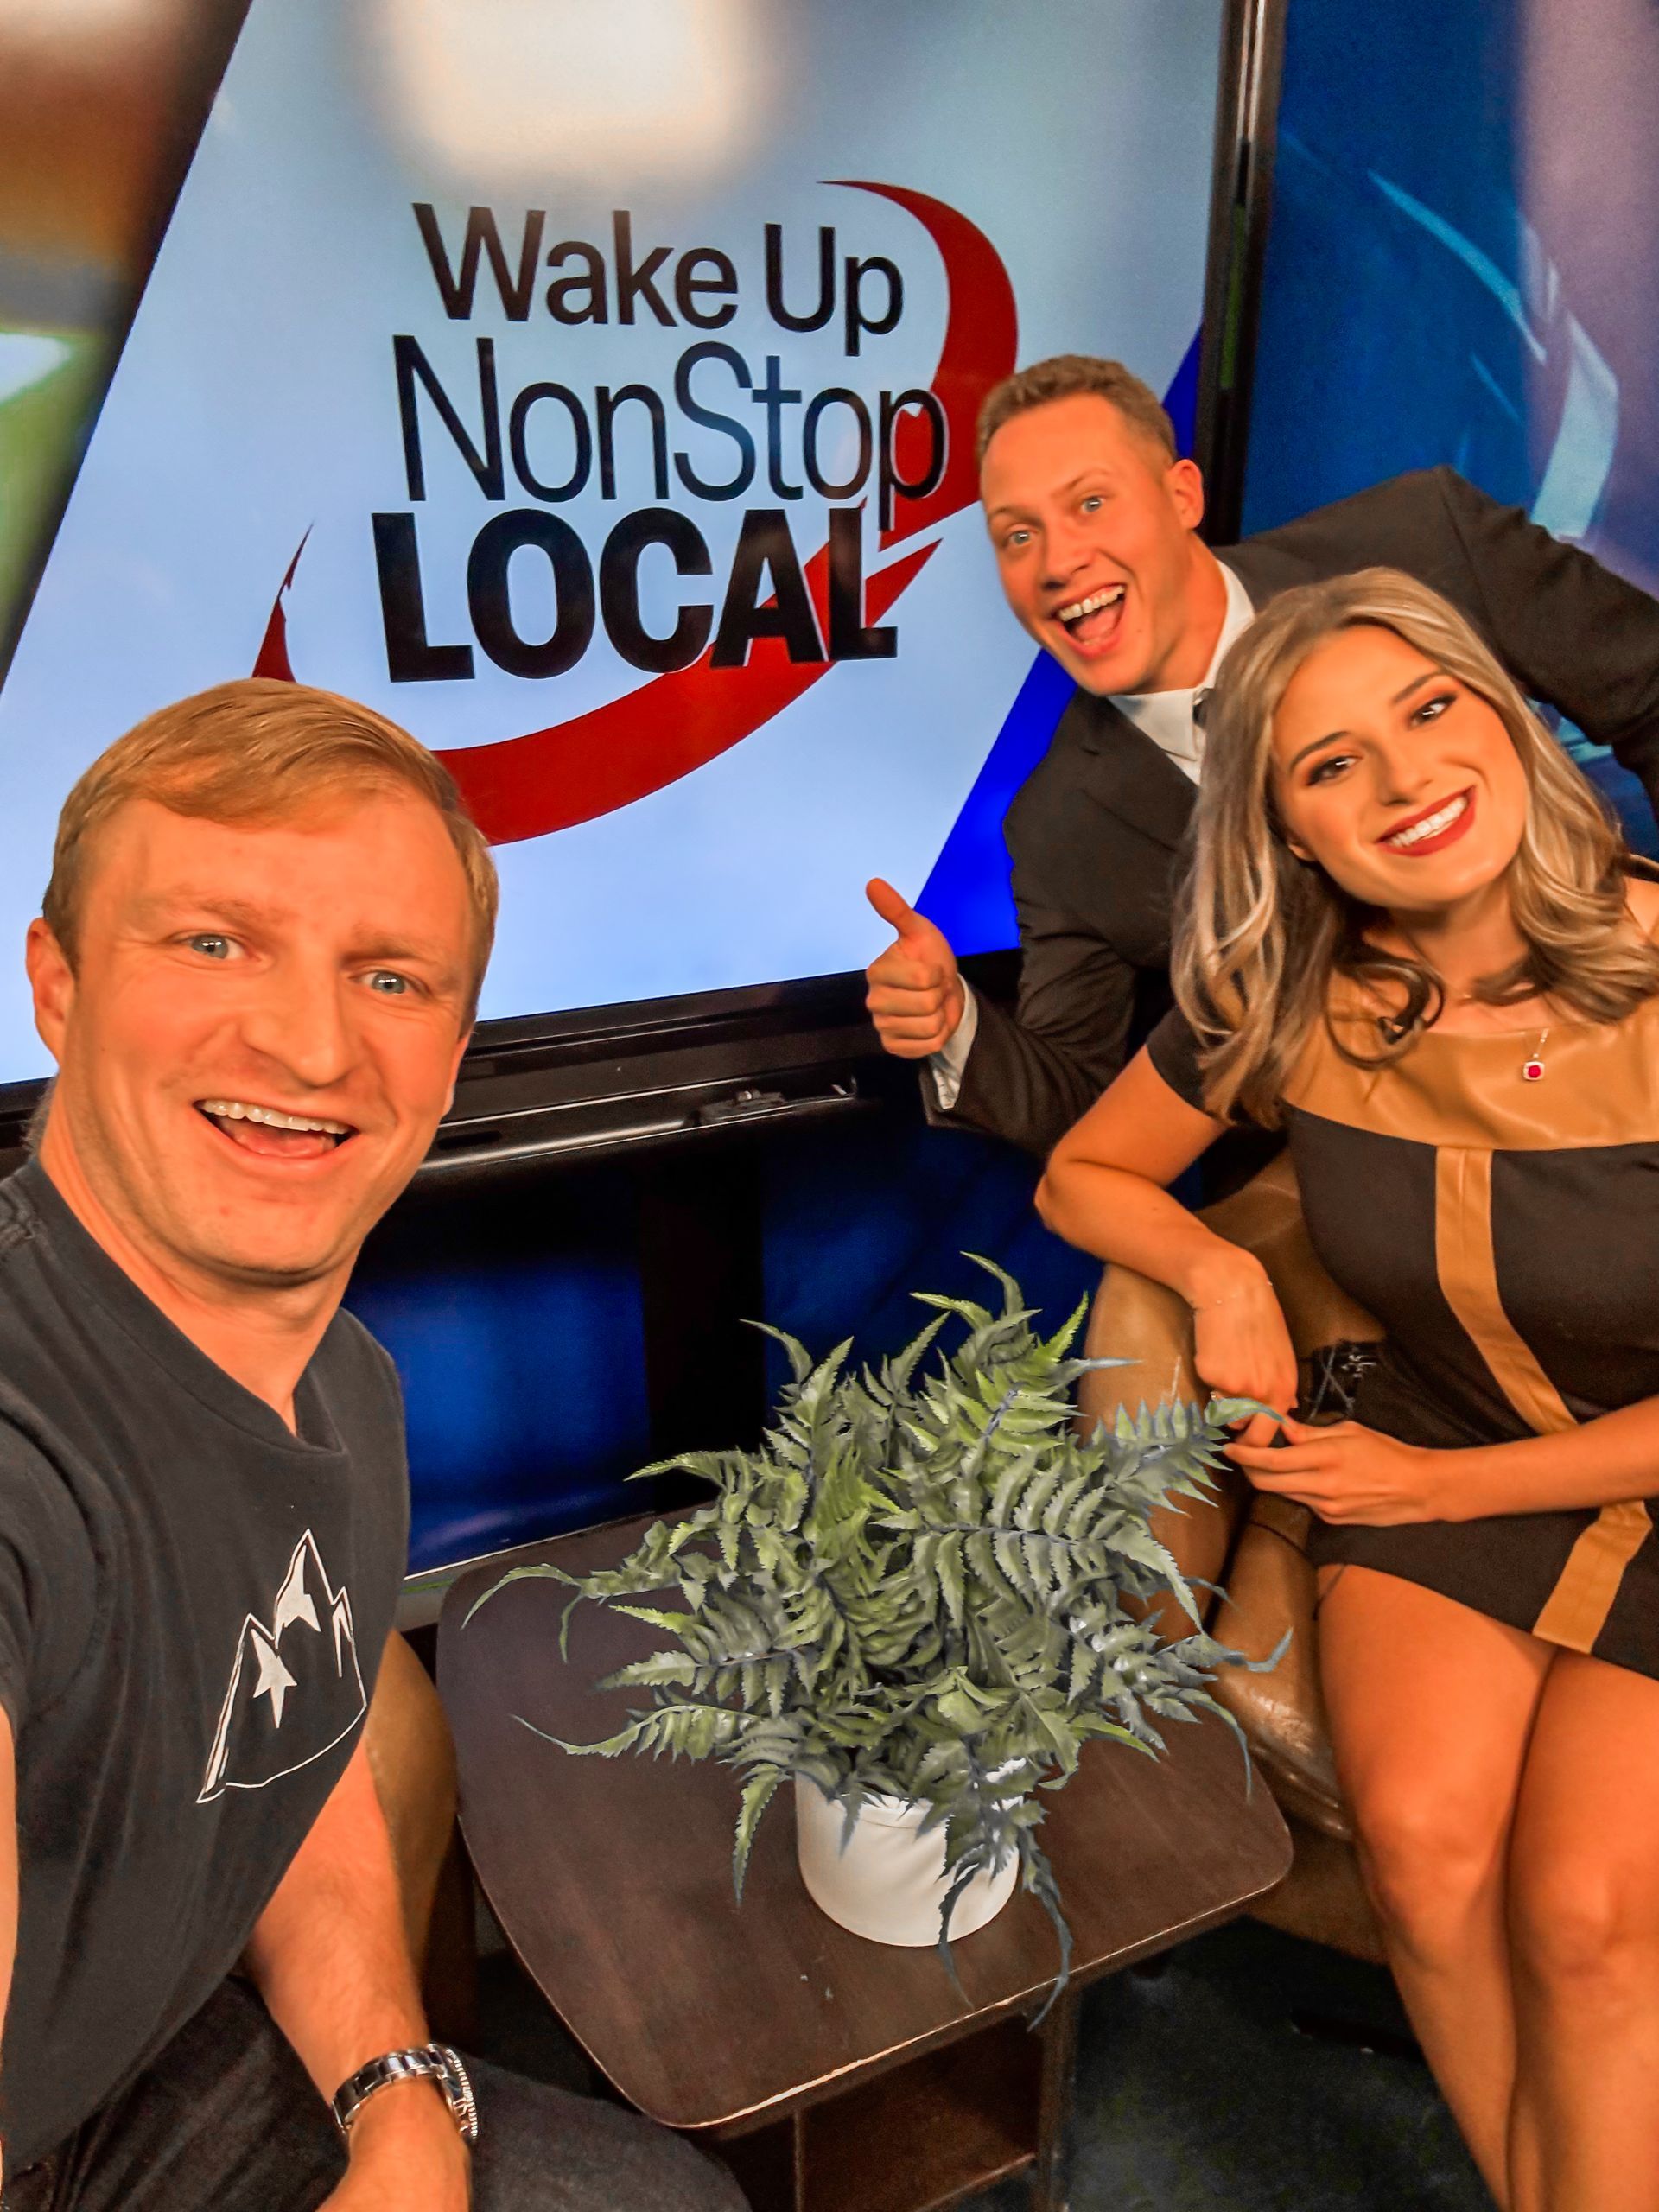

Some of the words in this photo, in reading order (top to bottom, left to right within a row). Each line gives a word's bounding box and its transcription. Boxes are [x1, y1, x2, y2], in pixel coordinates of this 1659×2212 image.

[411, 202, 738, 329] Wake
[765, 224, 903, 356] Up
[392, 334, 948, 531] NonStop
[371, 507, 898, 683] LOCAL
